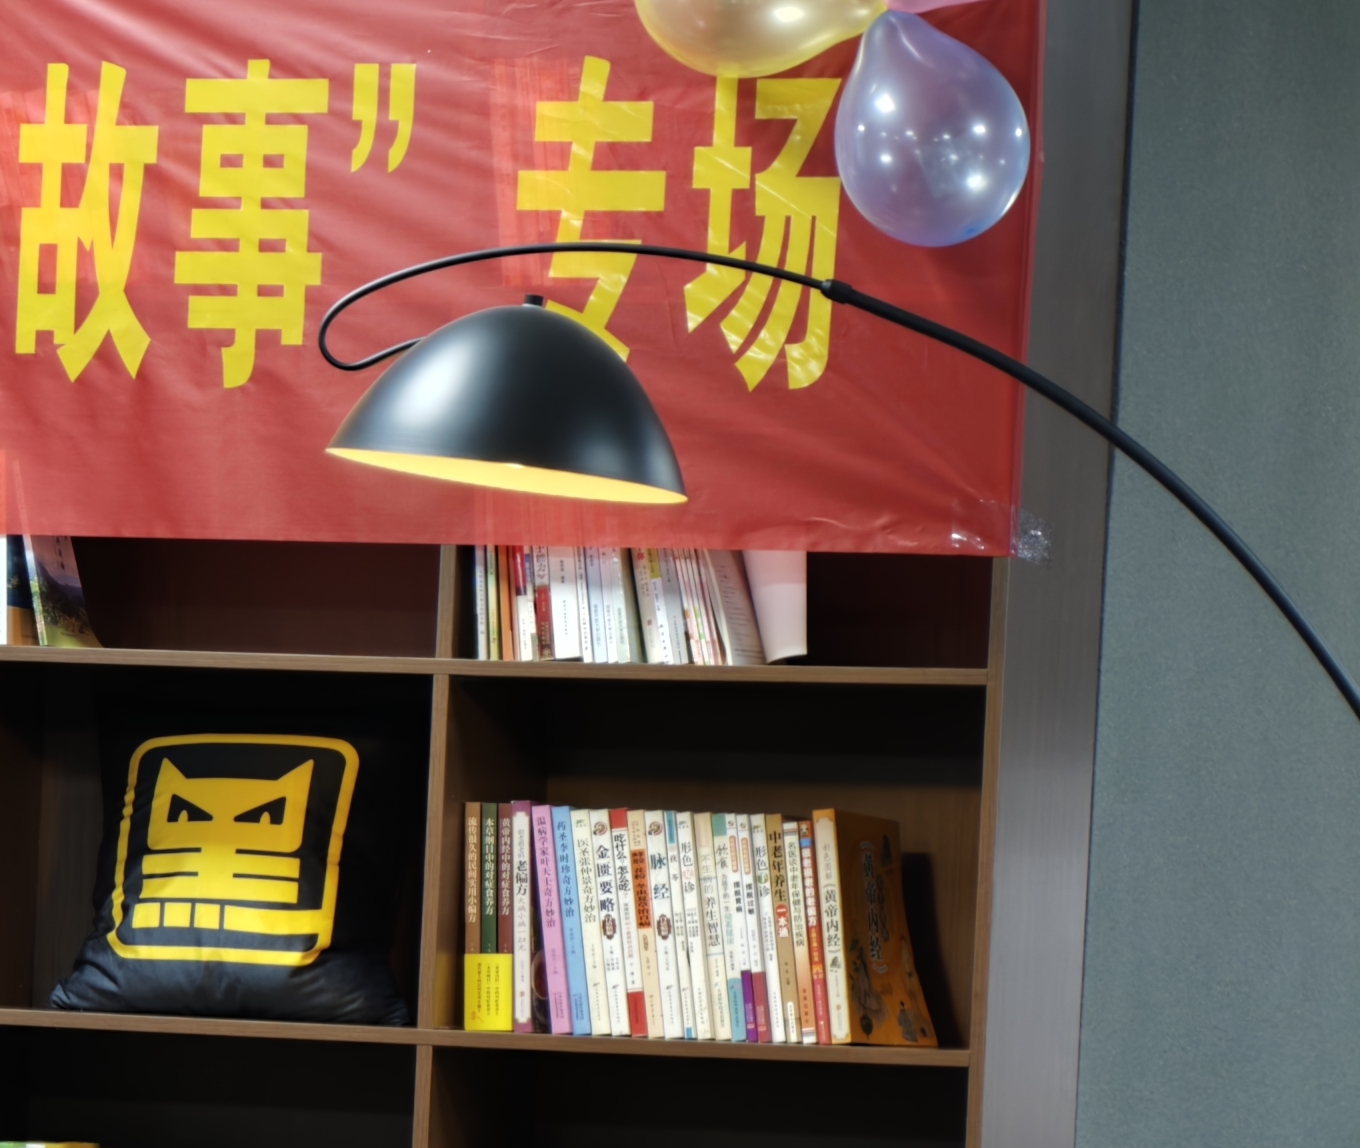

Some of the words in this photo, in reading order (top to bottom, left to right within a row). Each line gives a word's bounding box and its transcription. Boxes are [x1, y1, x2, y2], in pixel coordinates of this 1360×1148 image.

[467, 816, 477, 923] 流传很久的民间实用小偏方
[485, 817, 494, 916] 本草纲目中的对症食养方
[500, 818, 511, 916] 黄帝内经中的对症食养方
[515, 859, 529, 896] 老偏方
[537, 817, 556, 928] 温病学家叶天士奇方妙治
[557, 820, 575, 918] 药圣李时珍奇方妙治
[577, 839, 596, 923] 医圣张仲景奇方妙治
[595, 844, 615, 913] 金匮要略
[650, 853, 670, 900] 脉经
